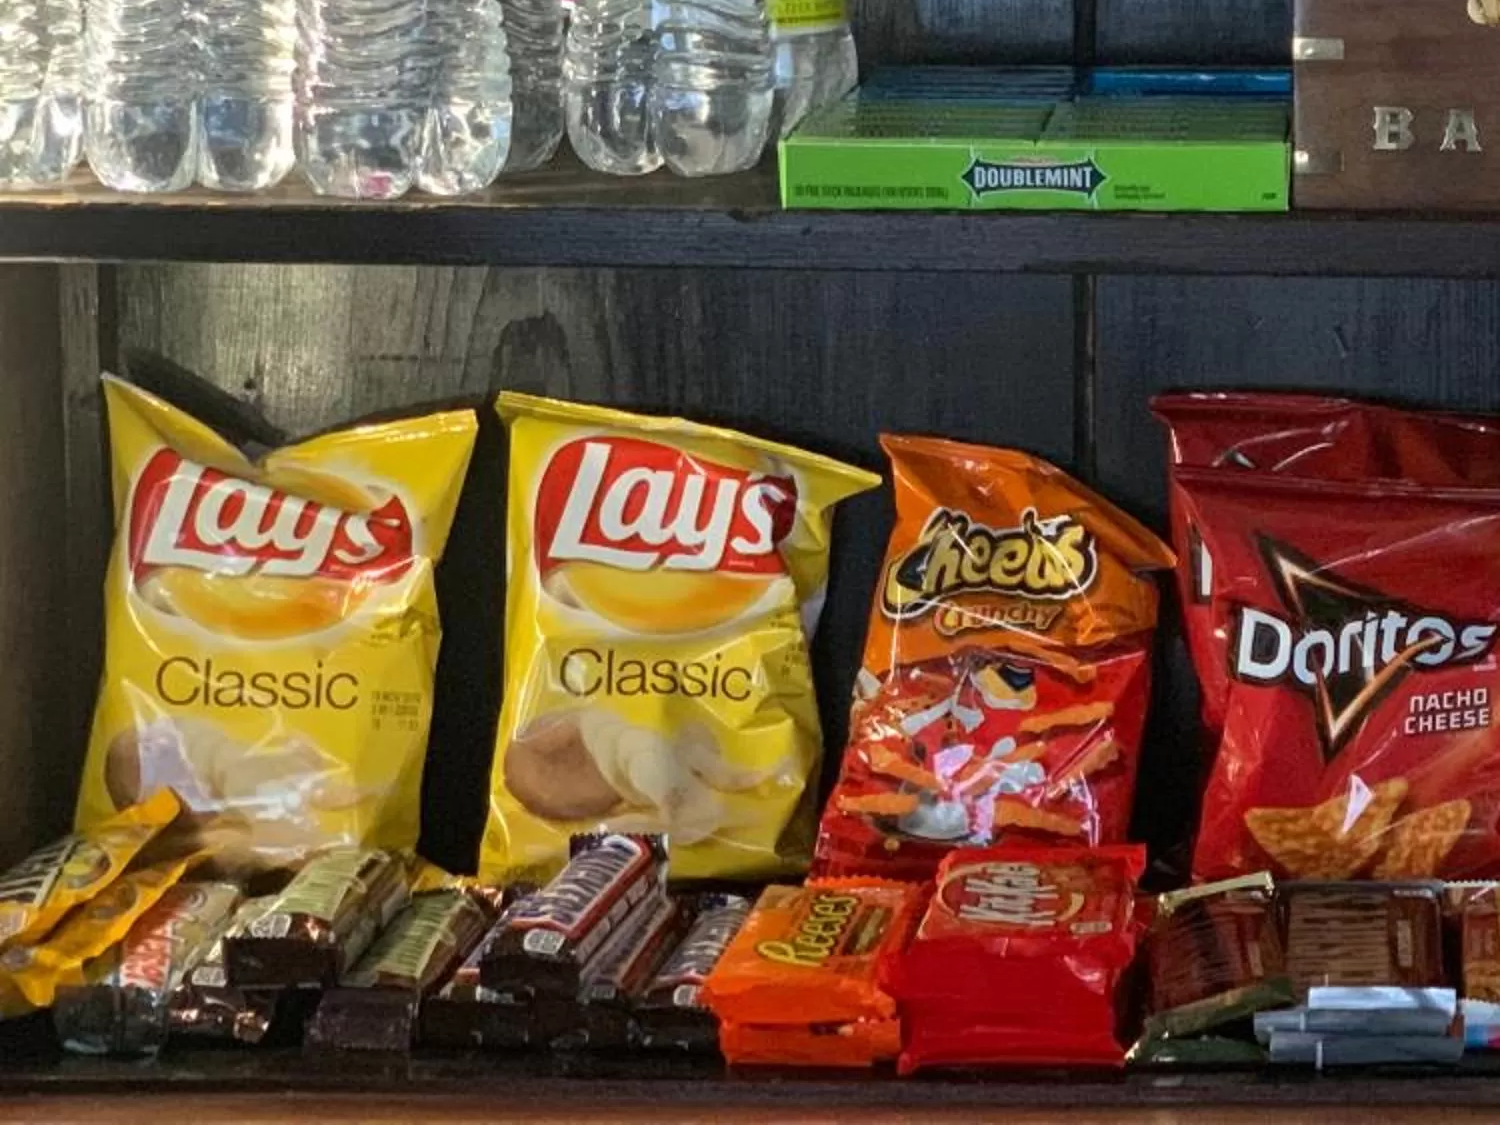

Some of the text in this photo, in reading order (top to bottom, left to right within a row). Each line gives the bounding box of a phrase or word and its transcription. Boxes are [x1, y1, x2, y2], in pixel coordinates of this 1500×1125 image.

[973, 167, 1095, 191] DOUBLEMINT
[933, 601, 1062, 636] Crunchy
[1237, 607, 1499, 684] Doritos
[155, 656, 359, 710] Classic
[559, 647, 753, 702] Classic
[1409, 687, 1488, 714] NACHO
[1403, 709, 1491, 734] CHEESE
